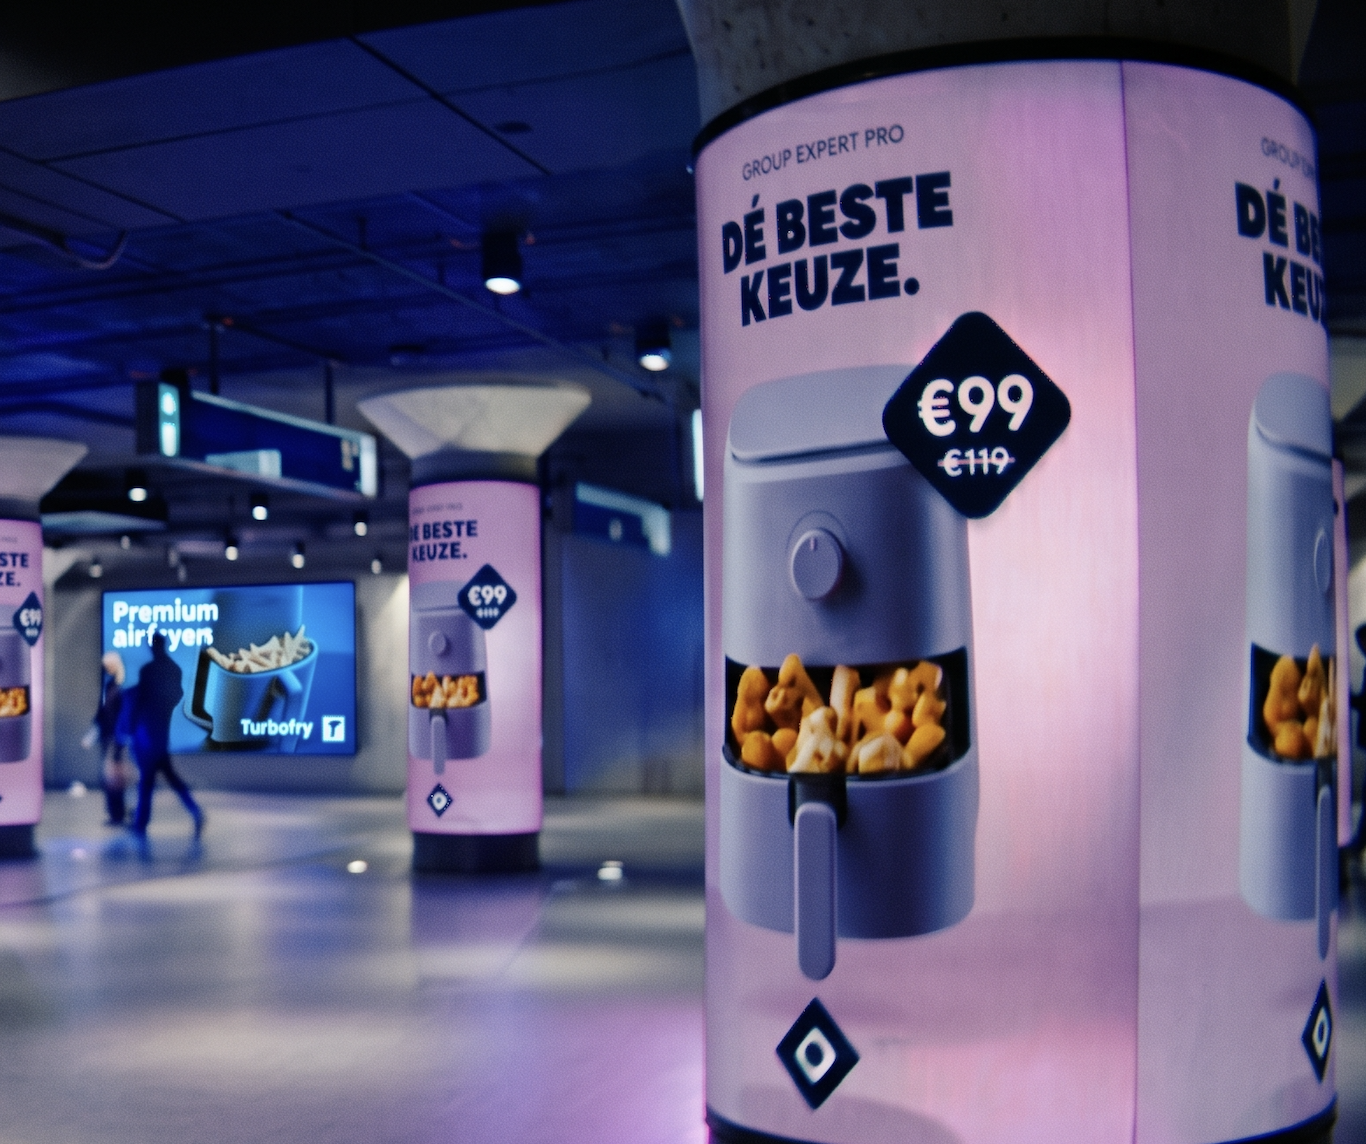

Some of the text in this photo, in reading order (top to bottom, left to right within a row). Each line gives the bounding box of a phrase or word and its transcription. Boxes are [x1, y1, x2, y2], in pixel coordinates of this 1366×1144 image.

[742, 124, 904, 181] GROUP EXPERT PRO
[722, 171, 953, 275] DÉ BESTE
[1235, 177, 1289, 248] DÉ
[741, 242, 920, 327] KEUZE.
[1262, 250, 1324, 323] KEU
[917, 374, 1034, 437] €99
[941, 446, 1011, 477] €119
[422, 520, 478, 540] BESTE
[113, 597, 218, 623] Premium
[467, 584, 507, 607] €99
[240, 717, 314, 740] Turbofry
